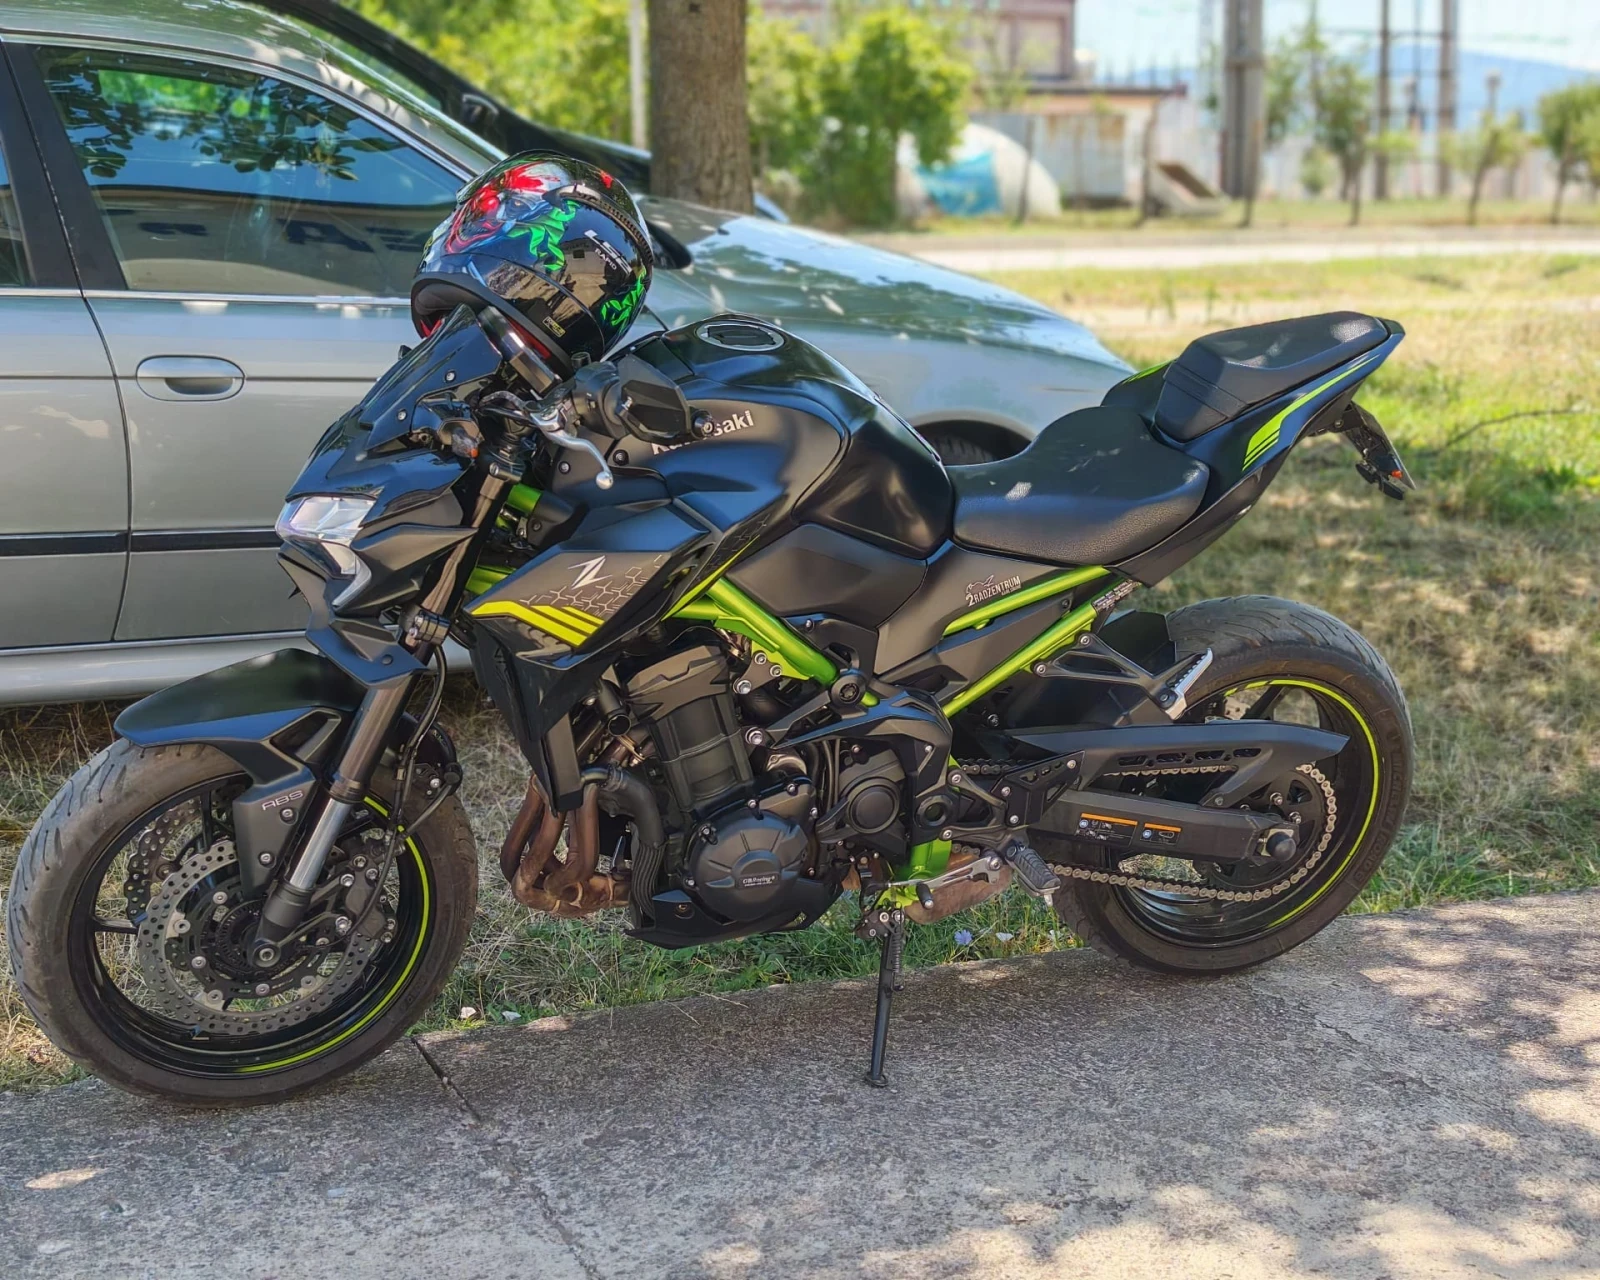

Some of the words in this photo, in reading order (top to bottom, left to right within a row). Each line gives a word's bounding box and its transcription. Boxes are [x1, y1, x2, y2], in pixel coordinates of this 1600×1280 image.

[584, 229, 633, 277] LS2
[594, 247, 618, 271] RAPID
[651, 409, 755, 455] Ksaki
[965, 575, 1021, 608] 2RADZENTRUM
[262, 790, 303, 811] ABS
